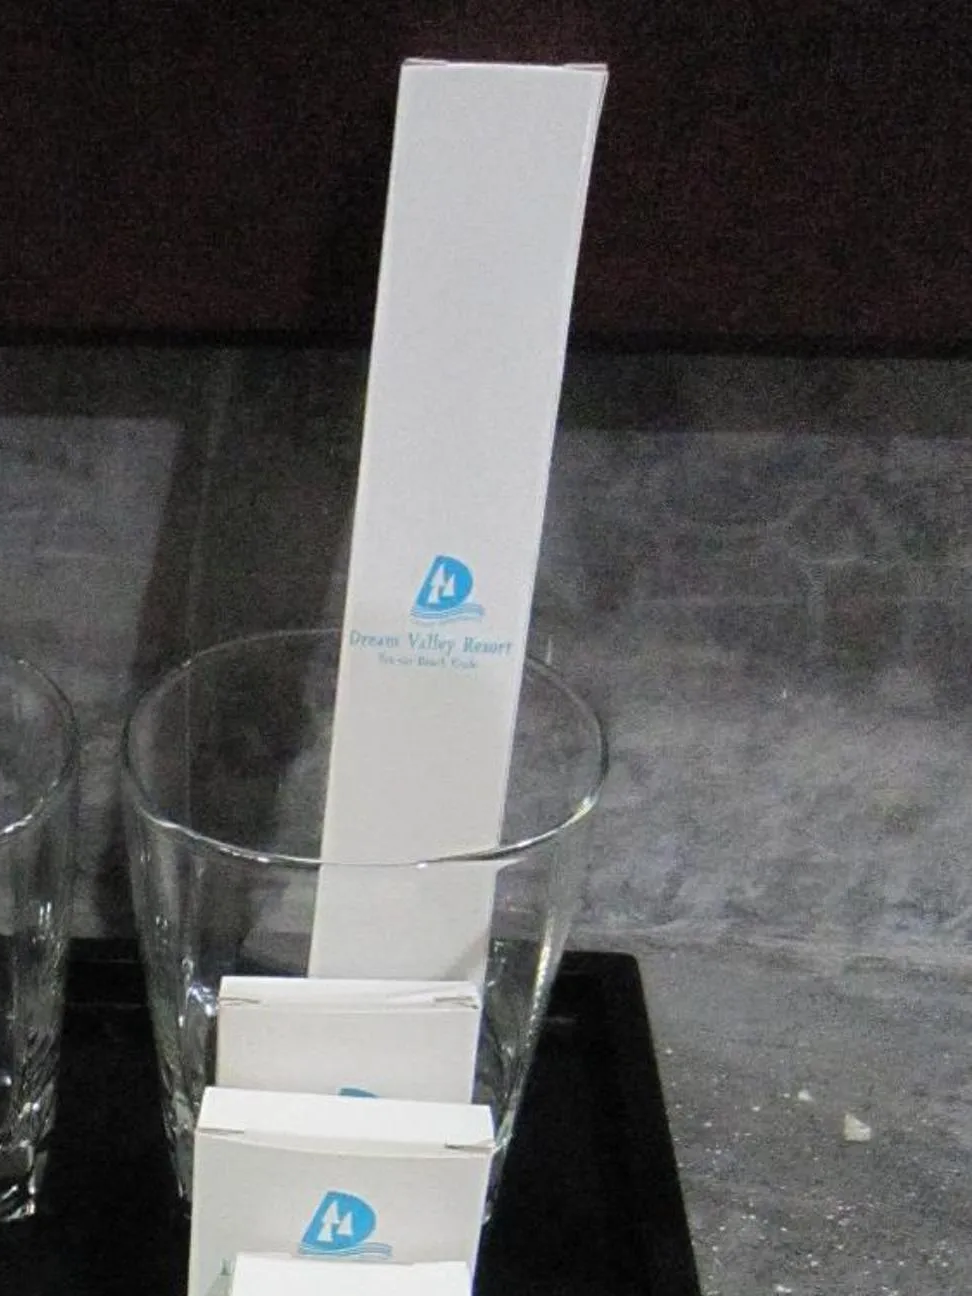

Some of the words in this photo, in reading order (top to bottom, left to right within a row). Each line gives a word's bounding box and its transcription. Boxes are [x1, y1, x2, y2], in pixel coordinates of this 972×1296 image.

[350, 630, 399, 647] Dream
[408, 631, 456, 655] Valley
[464, 636, 513, 656] Resort
